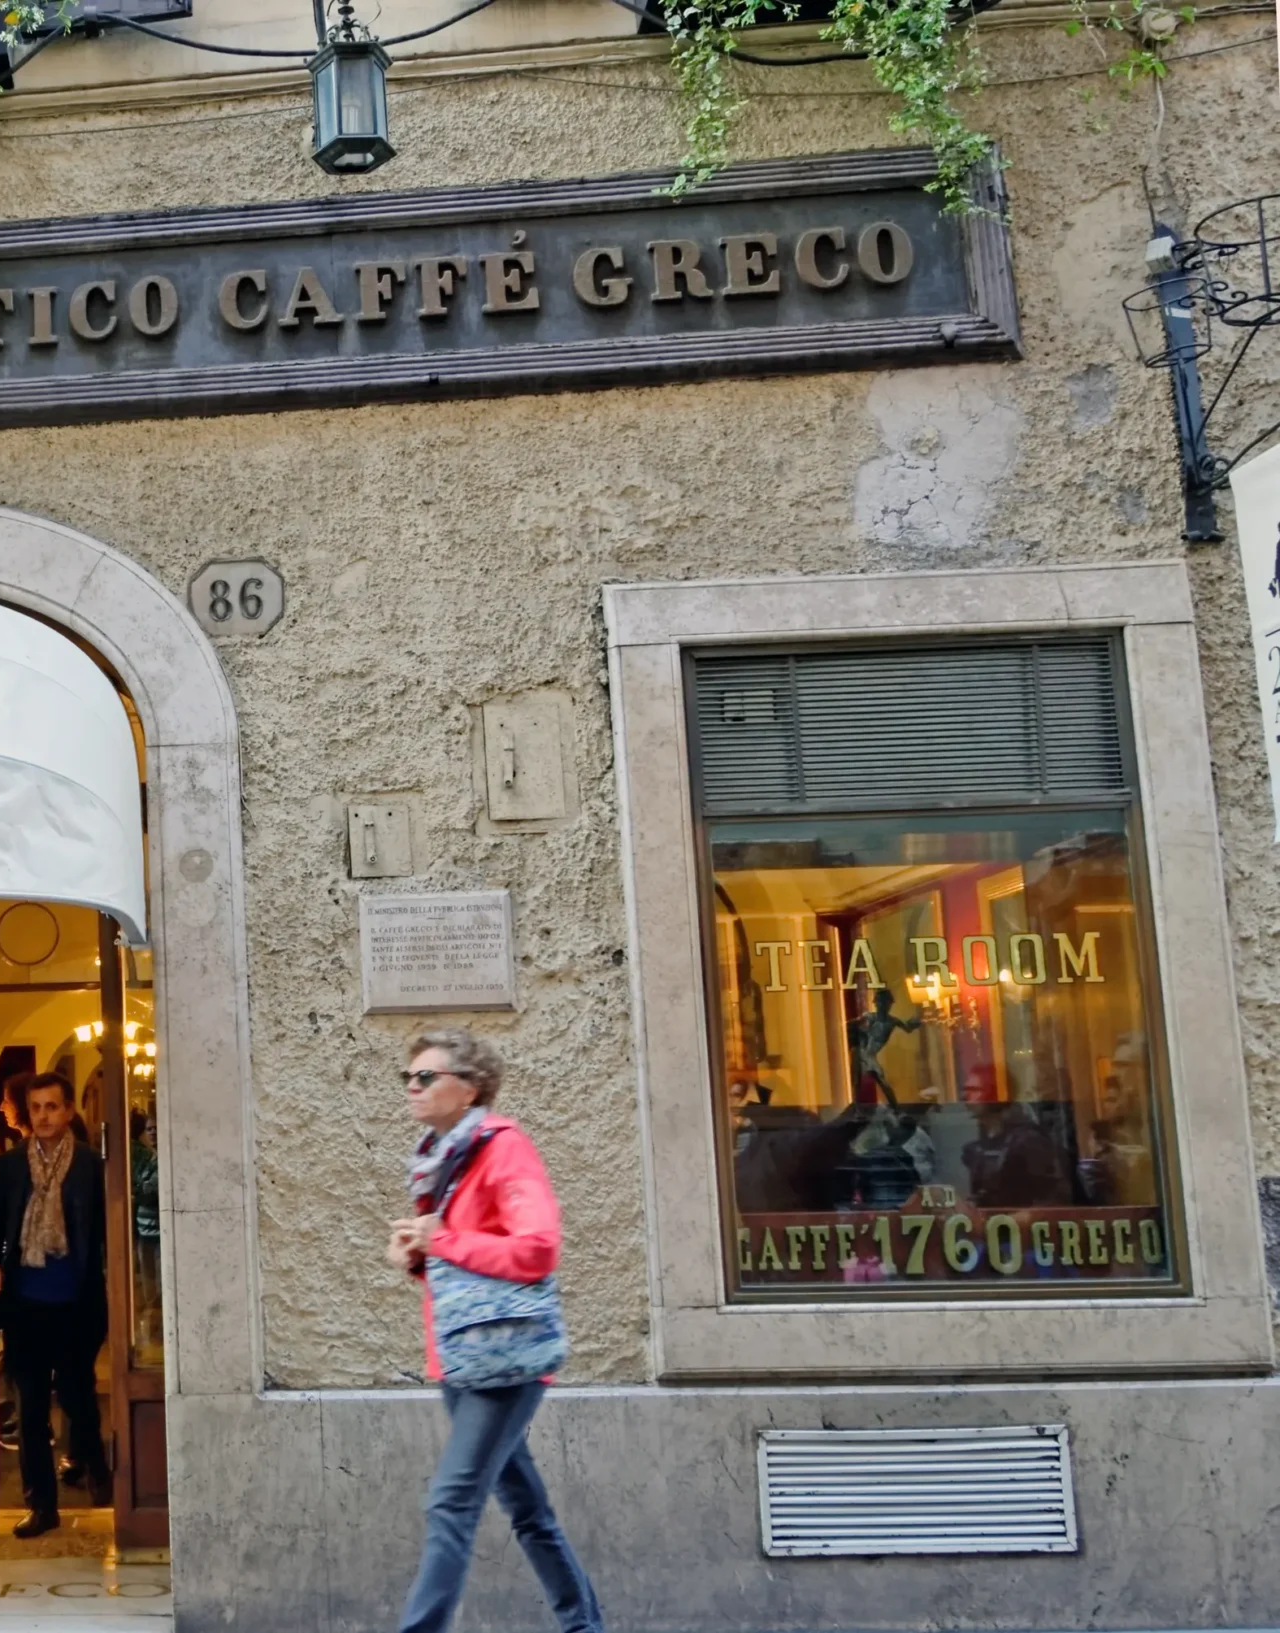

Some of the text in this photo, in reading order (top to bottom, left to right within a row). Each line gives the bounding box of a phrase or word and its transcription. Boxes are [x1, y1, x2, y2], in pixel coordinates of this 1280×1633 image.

[573, 221, 914, 307] GRECO
[208, 577, 264, 622] 86
[404, 925, 433, 933] GRECO
[472, 952, 499, 960] LEGGE
[755, 931, 1106, 992] TEA ROOM
[400, 984, 438, 992] DECRETO
[872, 1213, 1022, 1275] 1760
[1031, 1219, 1162, 1268] GRECO
